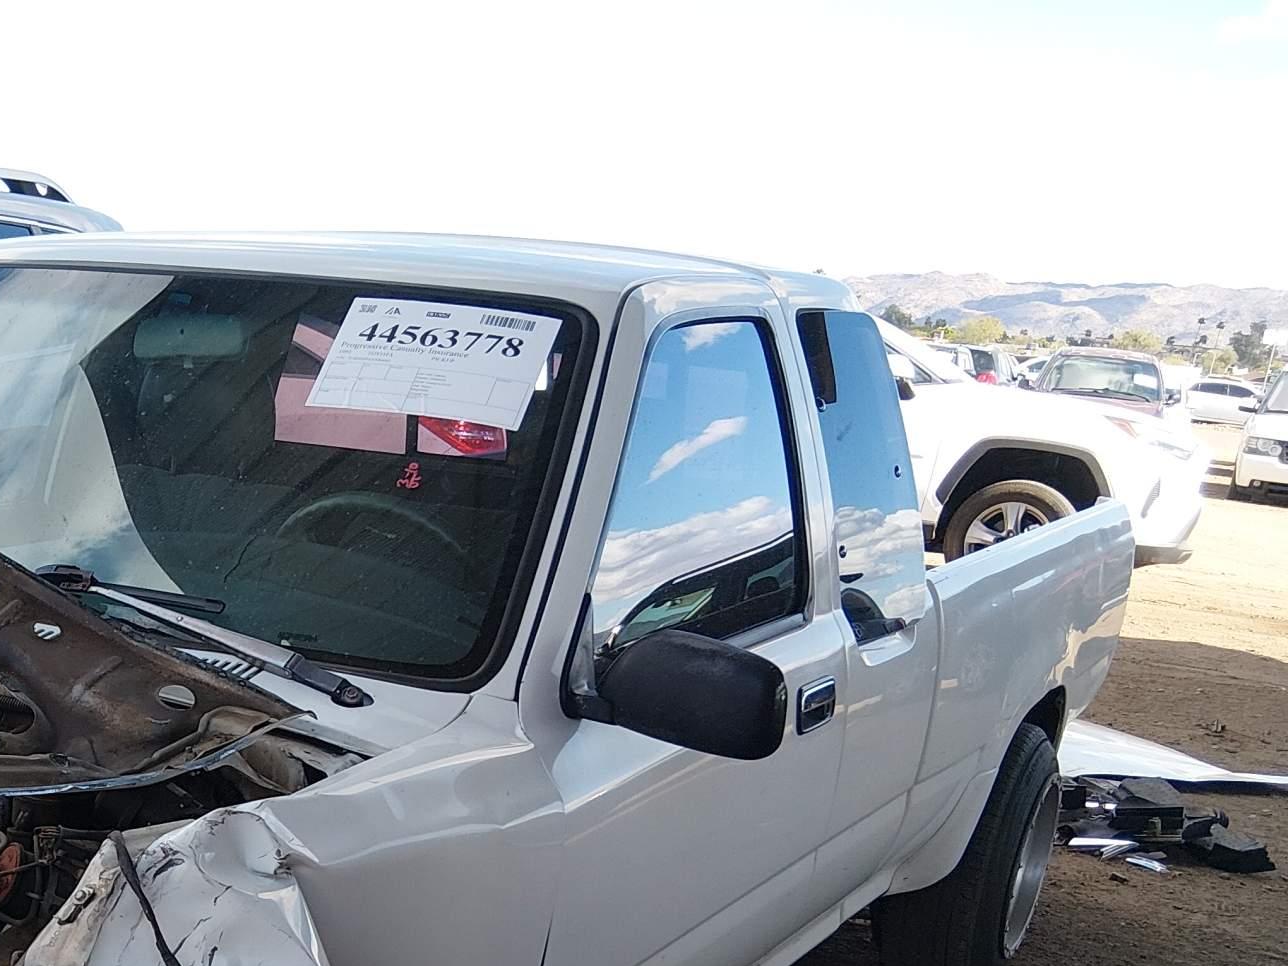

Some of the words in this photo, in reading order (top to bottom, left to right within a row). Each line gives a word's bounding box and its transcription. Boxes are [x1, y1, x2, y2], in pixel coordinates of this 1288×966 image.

[341, 341, 388, 351] Progressive
[391, 344, 426, 355] Casualty
[427, 347, 470, 359] Insurance
[358, 323, 525, 358] 44563778
